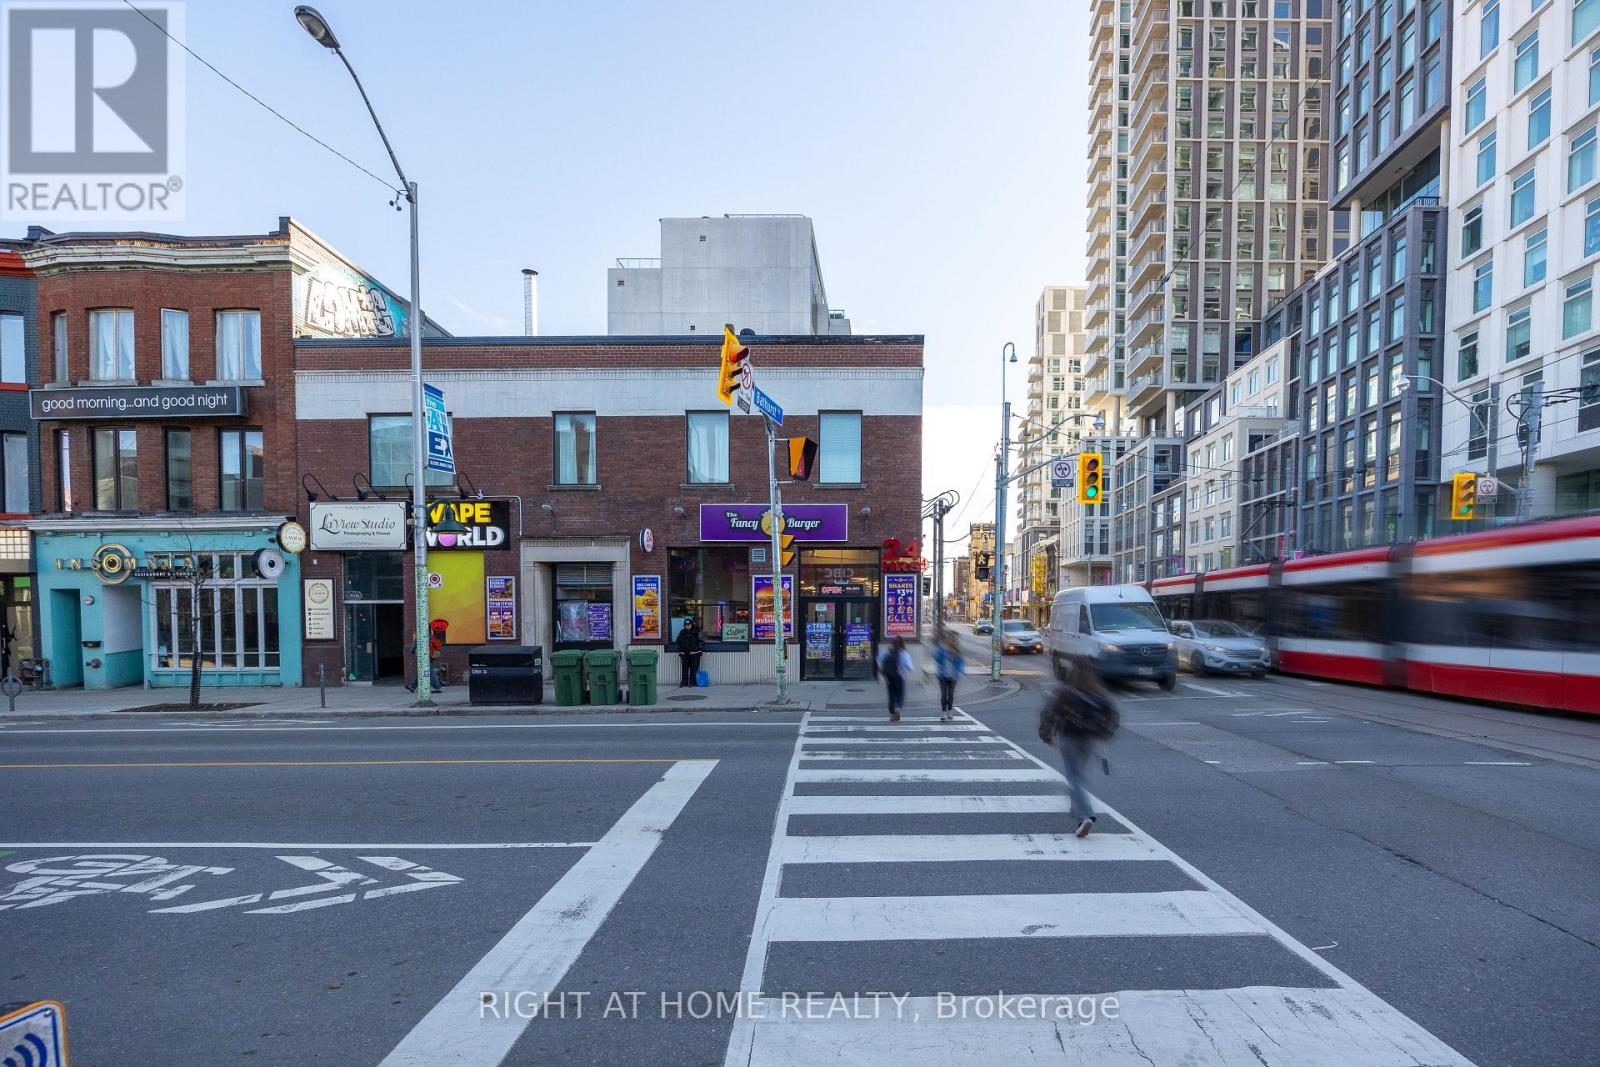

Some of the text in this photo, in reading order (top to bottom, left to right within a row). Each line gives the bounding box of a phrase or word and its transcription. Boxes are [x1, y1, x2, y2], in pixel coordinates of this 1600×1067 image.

[42, 397, 74, 412] good
[162, 394, 195, 410] good
[197, 393, 228, 409] night
[756, 391, 777, 418] Bathurst
[361, 517, 396, 529] Studio
[730, 517, 759, 530] Fancy
[787, 517, 821, 530] Burger
[882, 538, 921, 560] 24
[821, 586, 842, 594] OPEN
